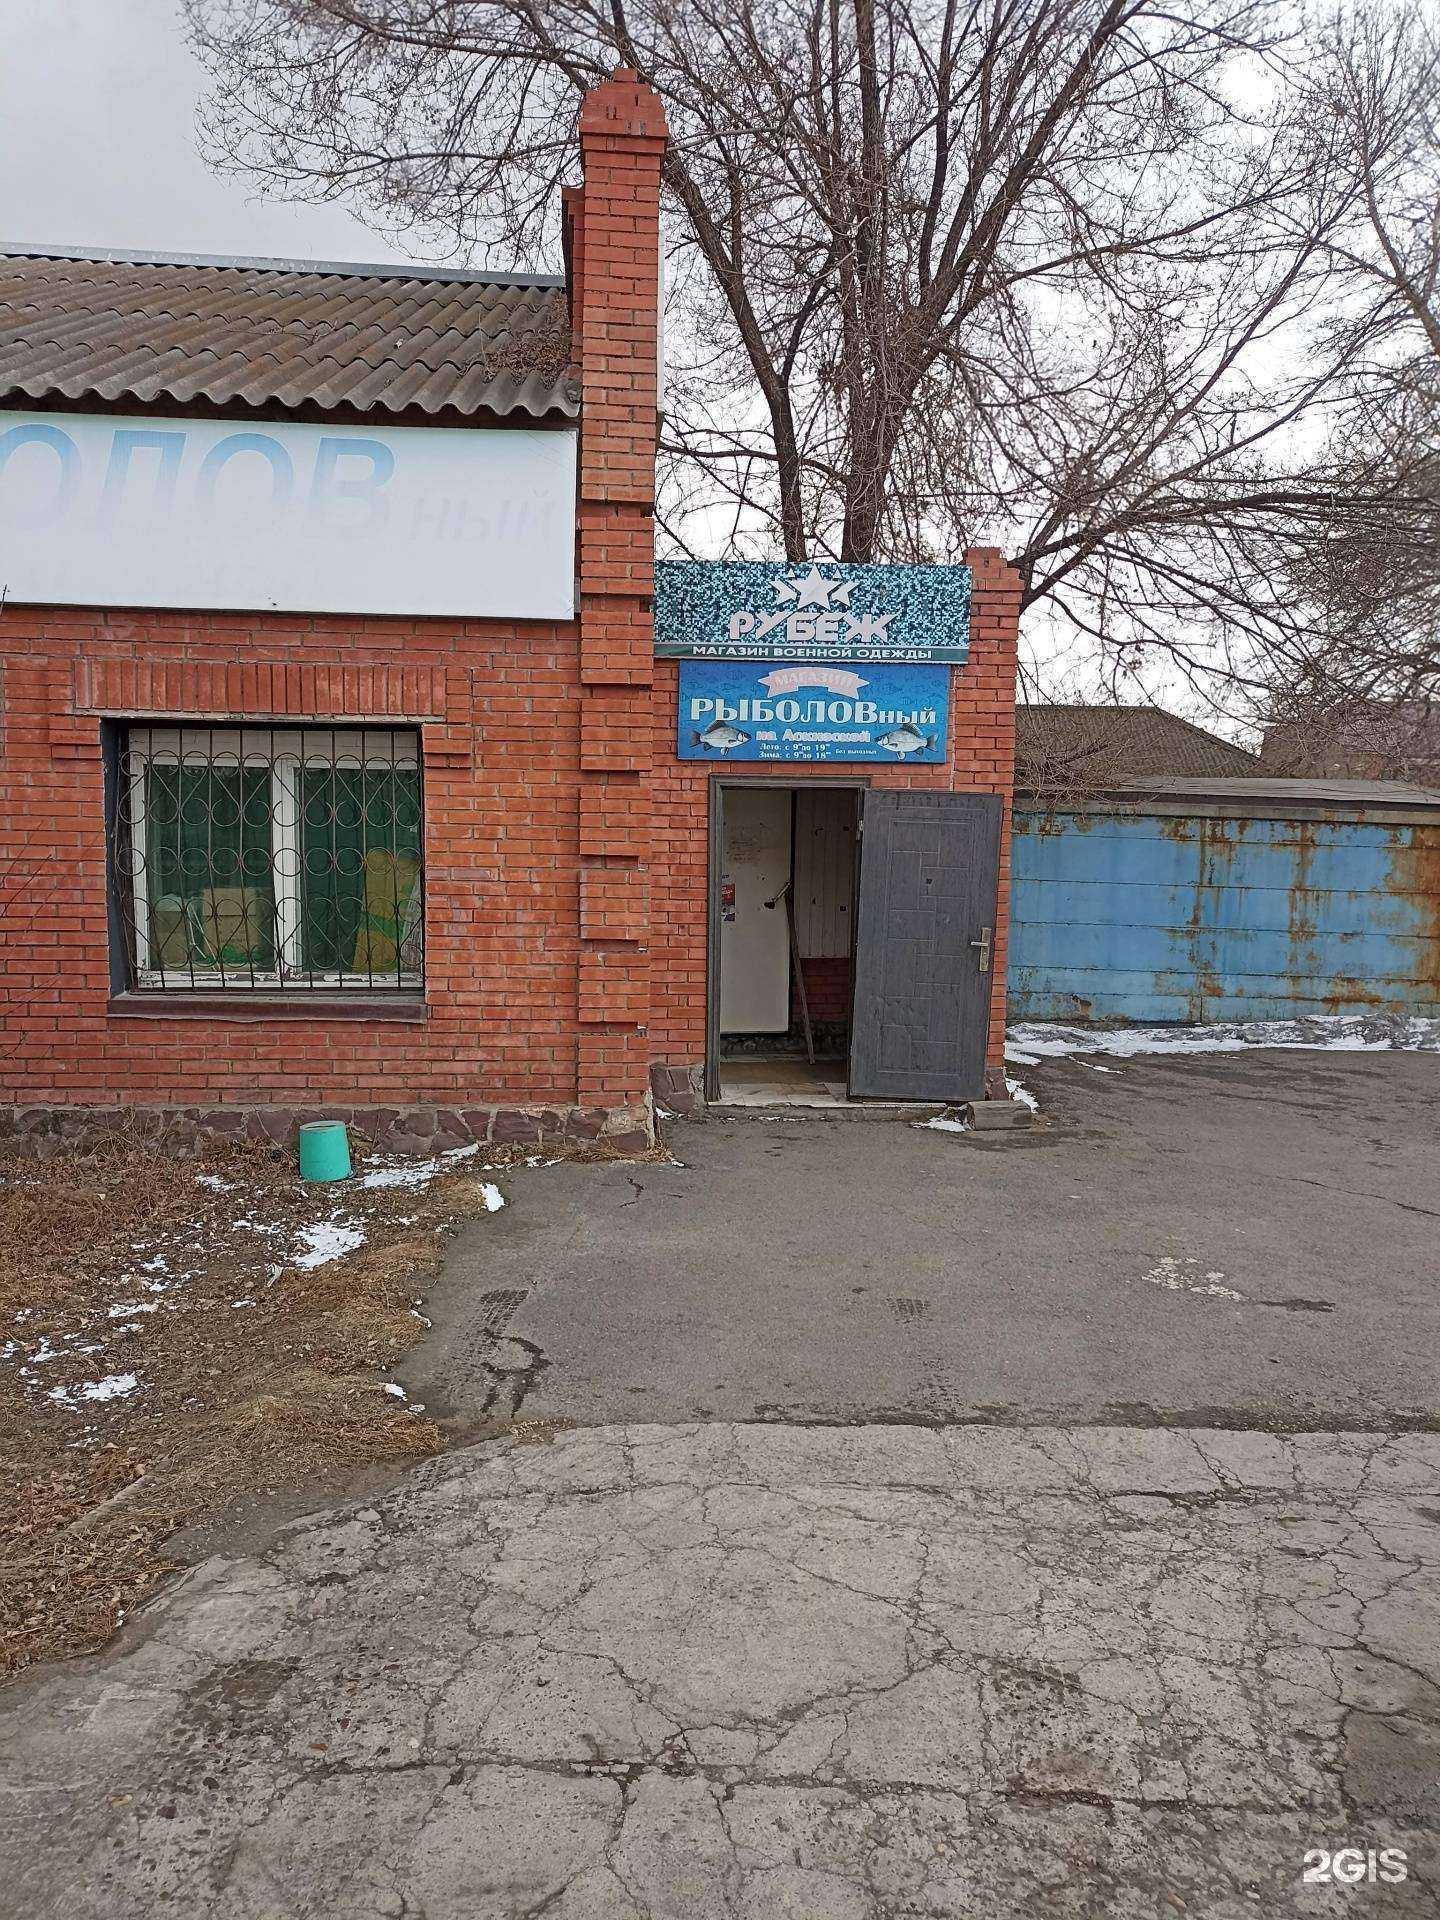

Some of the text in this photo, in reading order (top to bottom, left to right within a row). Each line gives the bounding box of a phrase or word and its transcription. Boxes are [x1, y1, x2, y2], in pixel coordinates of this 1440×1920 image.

[729, 610, 898, 643] РУБЕЖ
[693, 646, 932, 659] МАГАЗИН ВОЕННОЙ ОДЕЖДЫ
[690, 698, 936, 724] РЫБОЛОВный
